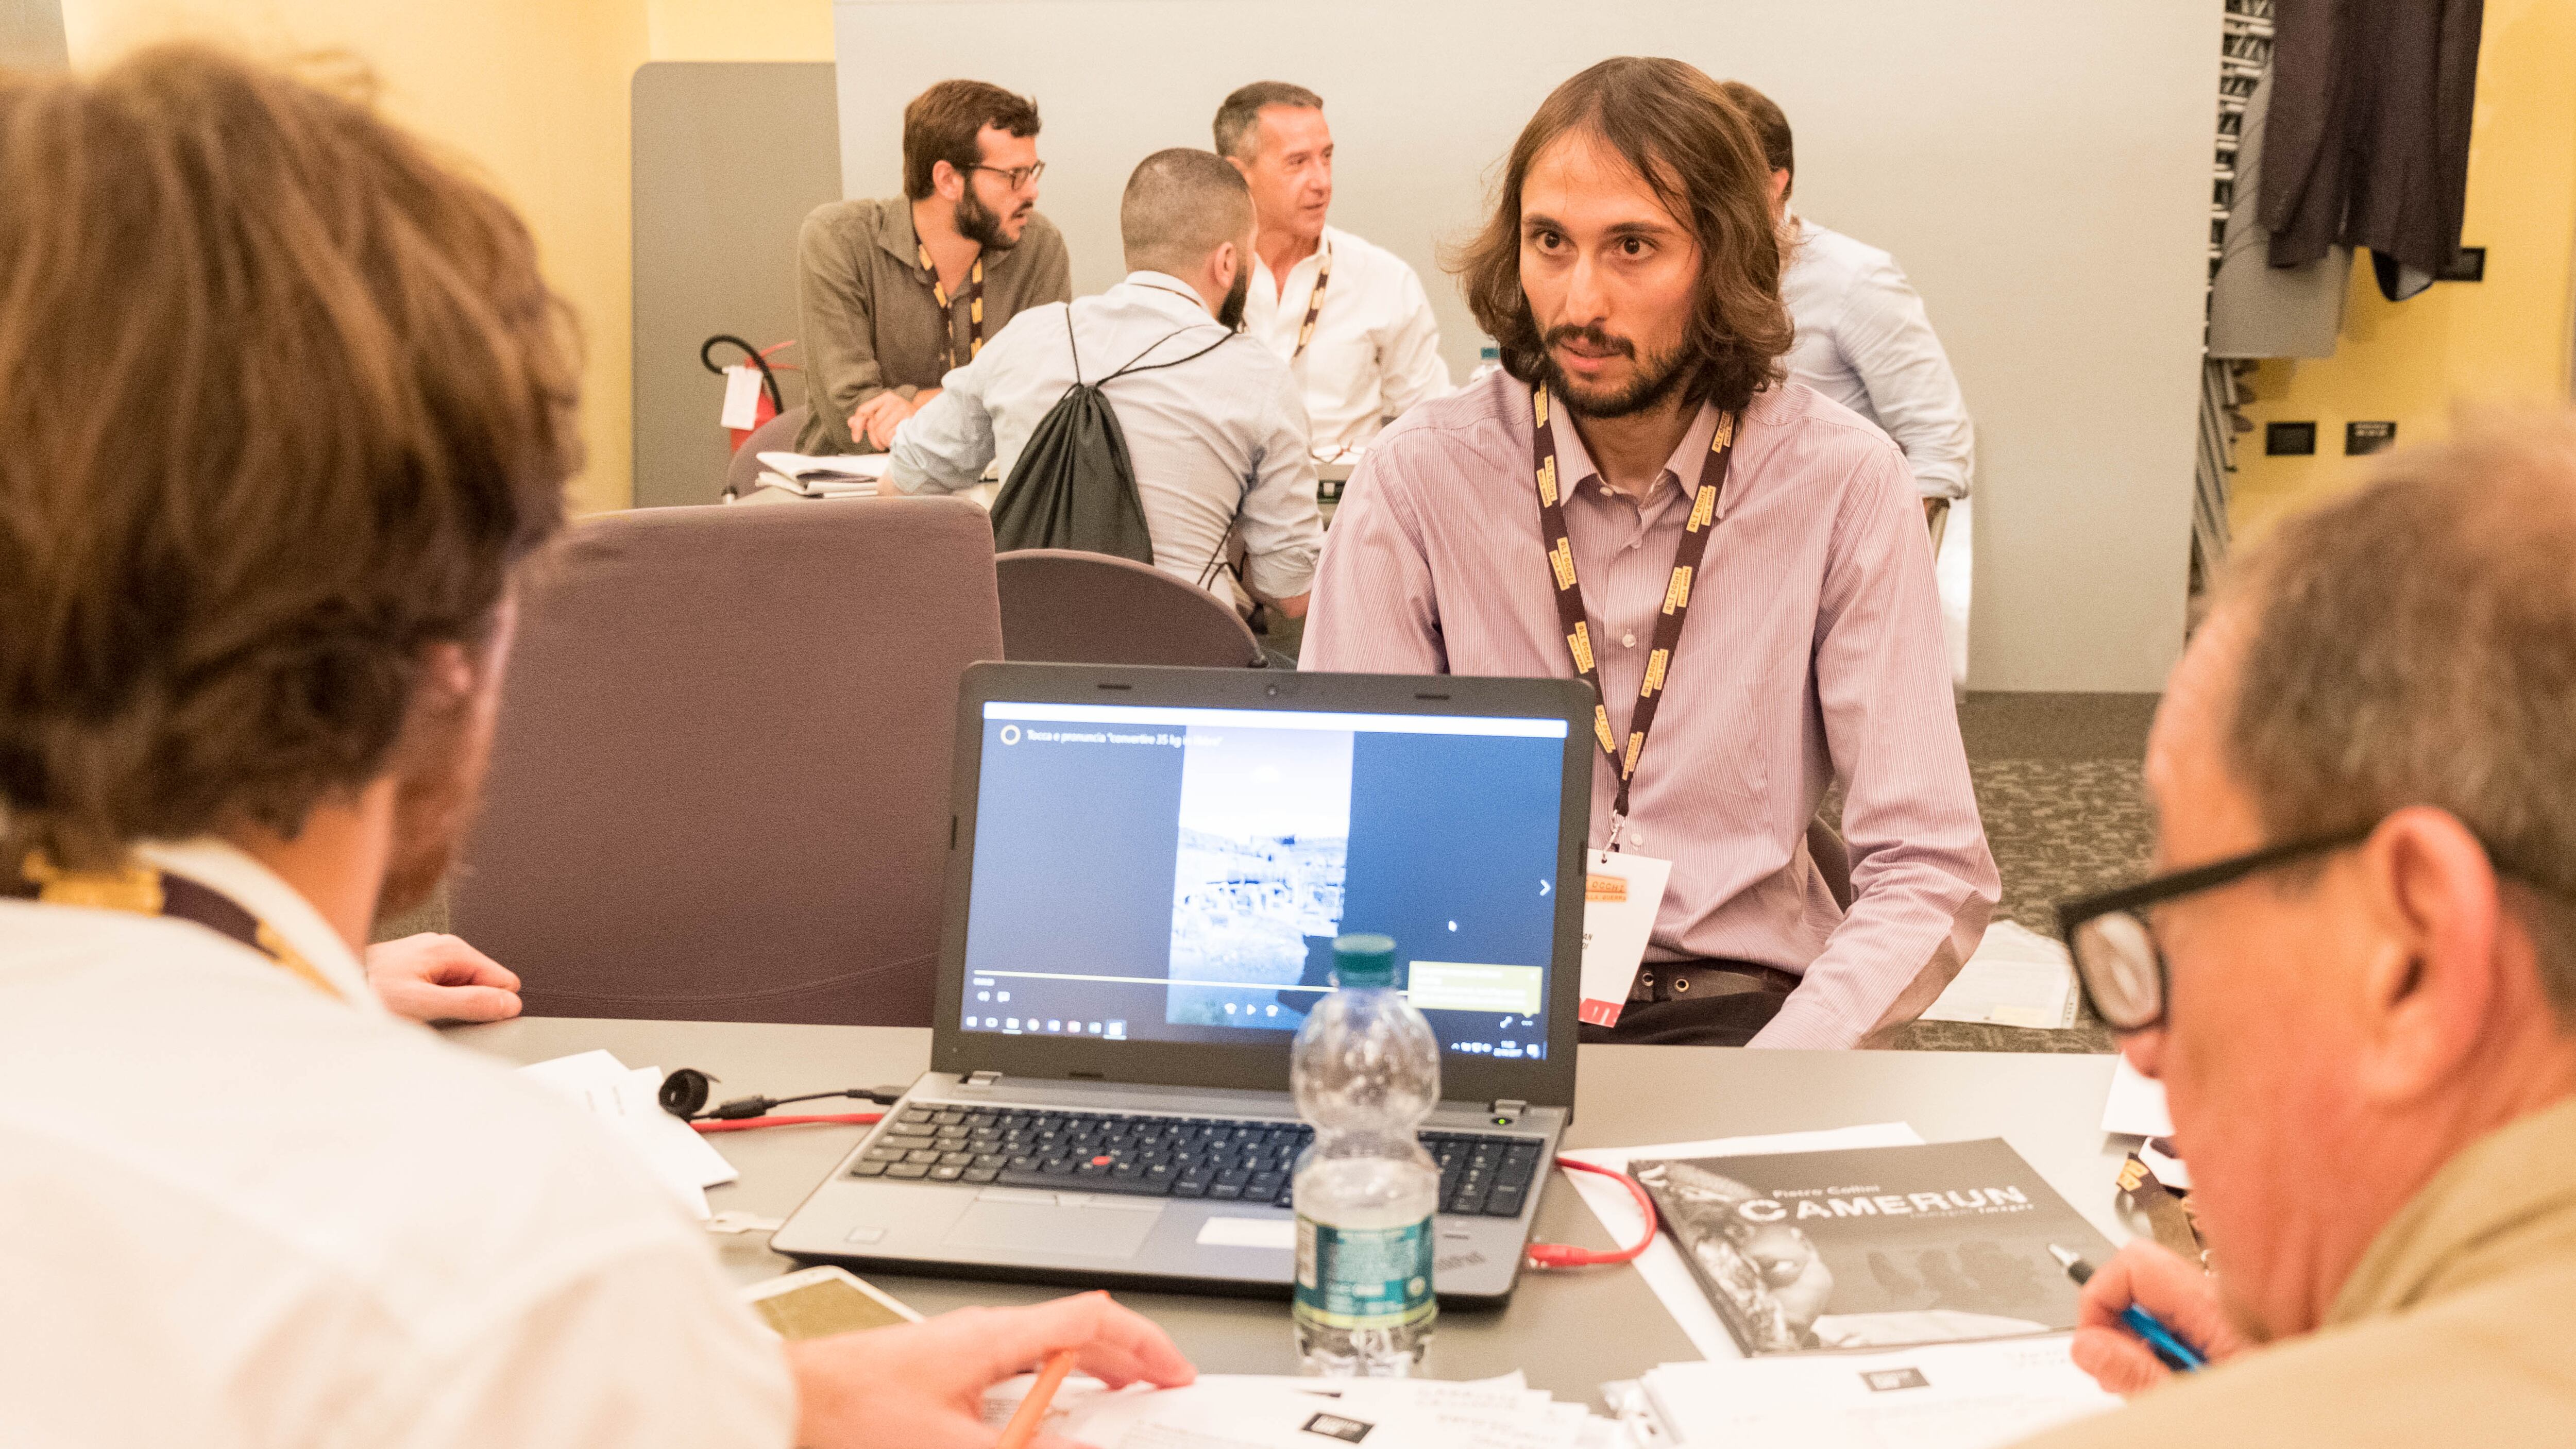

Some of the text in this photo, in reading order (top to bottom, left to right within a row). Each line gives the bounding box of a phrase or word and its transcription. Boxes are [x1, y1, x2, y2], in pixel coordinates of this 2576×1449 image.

[1696, 490, 1707, 513] OCCHI
[1564, 558, 1574, 581] OCCHI
[1670, 572, 1682, 594] OCCHI
[1582, 642, 1592, 664] OCCHI
[1649, 654, 1659, 677] OCCHI
[1592, 881, 1624, 892] OCCHI
[1738, 1185, 2029, 1222] CAMERUN
